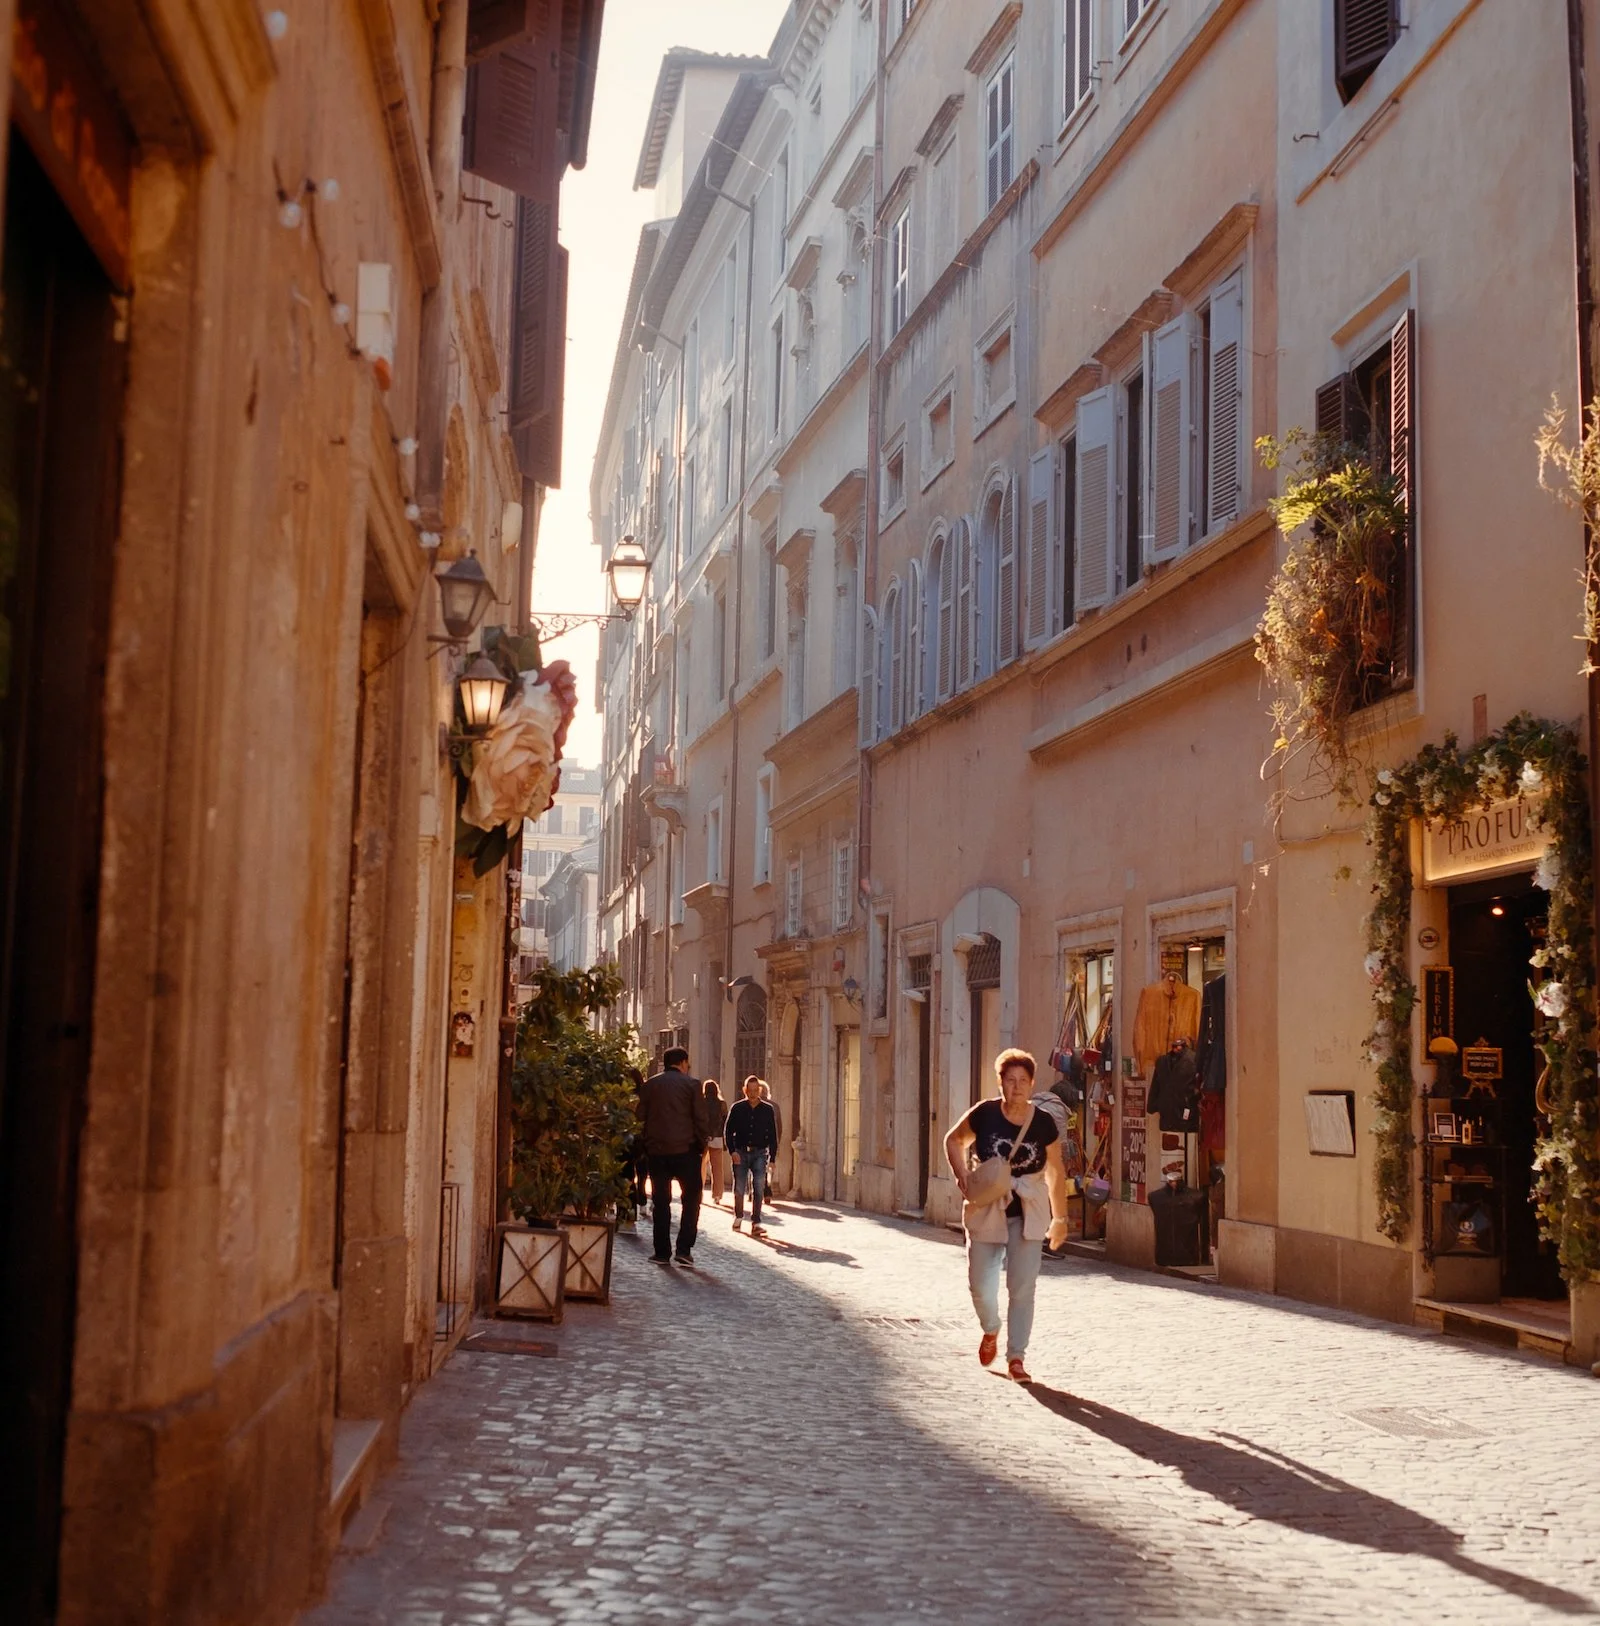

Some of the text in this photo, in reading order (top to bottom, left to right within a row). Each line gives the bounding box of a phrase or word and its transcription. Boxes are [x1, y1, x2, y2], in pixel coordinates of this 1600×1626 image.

[1433, 972, 1443, 1036] PERFUM
[1130, 1131, 1146, 1154] 20%
[1129, 1160, 1146, 1184] 60%
